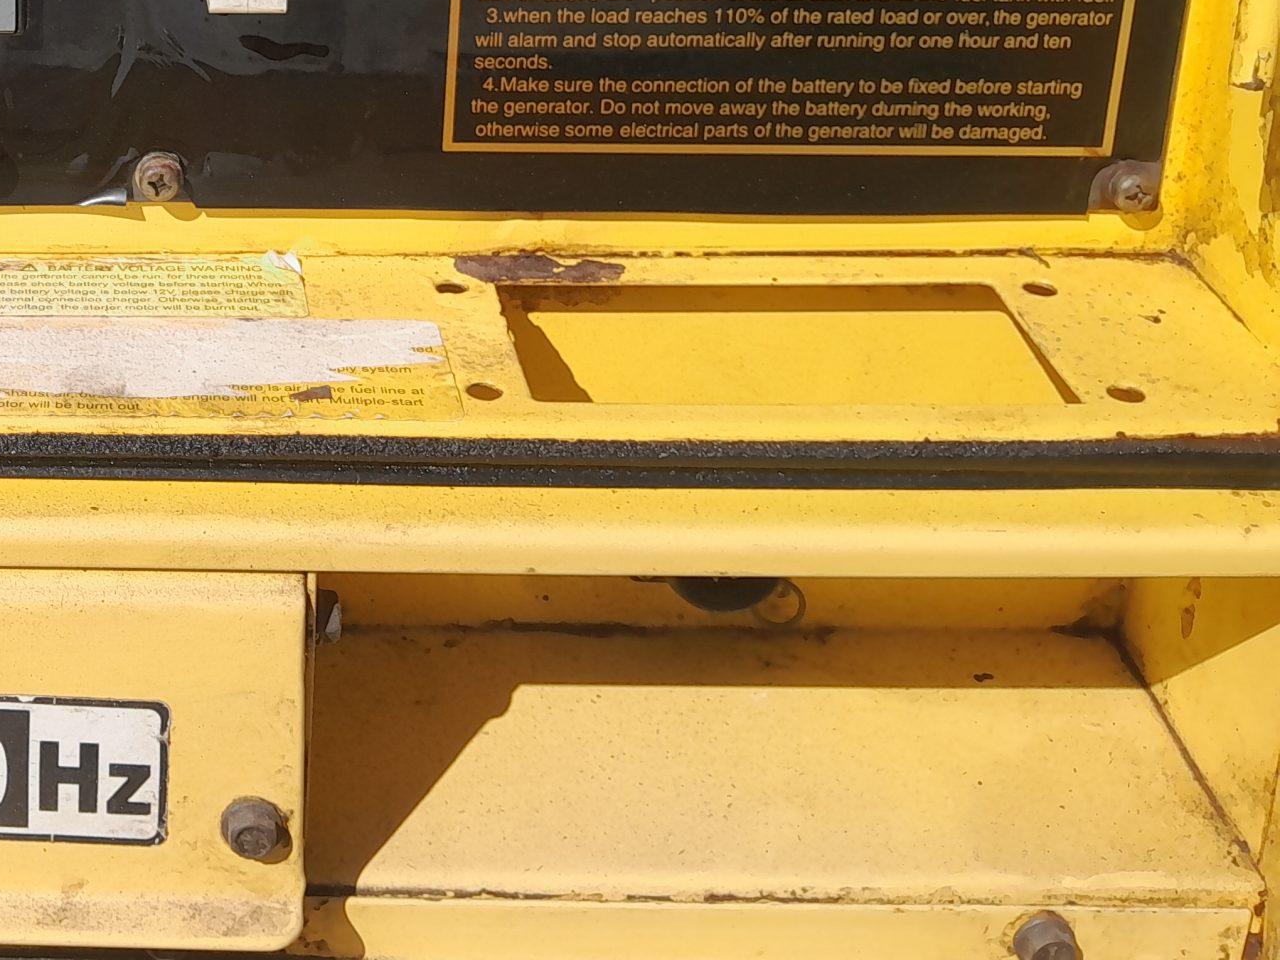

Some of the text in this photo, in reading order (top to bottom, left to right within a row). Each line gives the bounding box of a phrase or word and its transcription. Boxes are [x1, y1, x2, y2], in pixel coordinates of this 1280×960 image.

[486, 6, 1114, 29] 3.when the load reaches 110% of the rated load or over, the generator
[350, 385, 376, 394] fuel
[28, 401, 50, 409] will
[55, 401, 72, 409] be
[77, 402, 114, 410] burnt
[329, 396, 425, 407] Multiple-start
[38, 740, 152, 816] Hz
